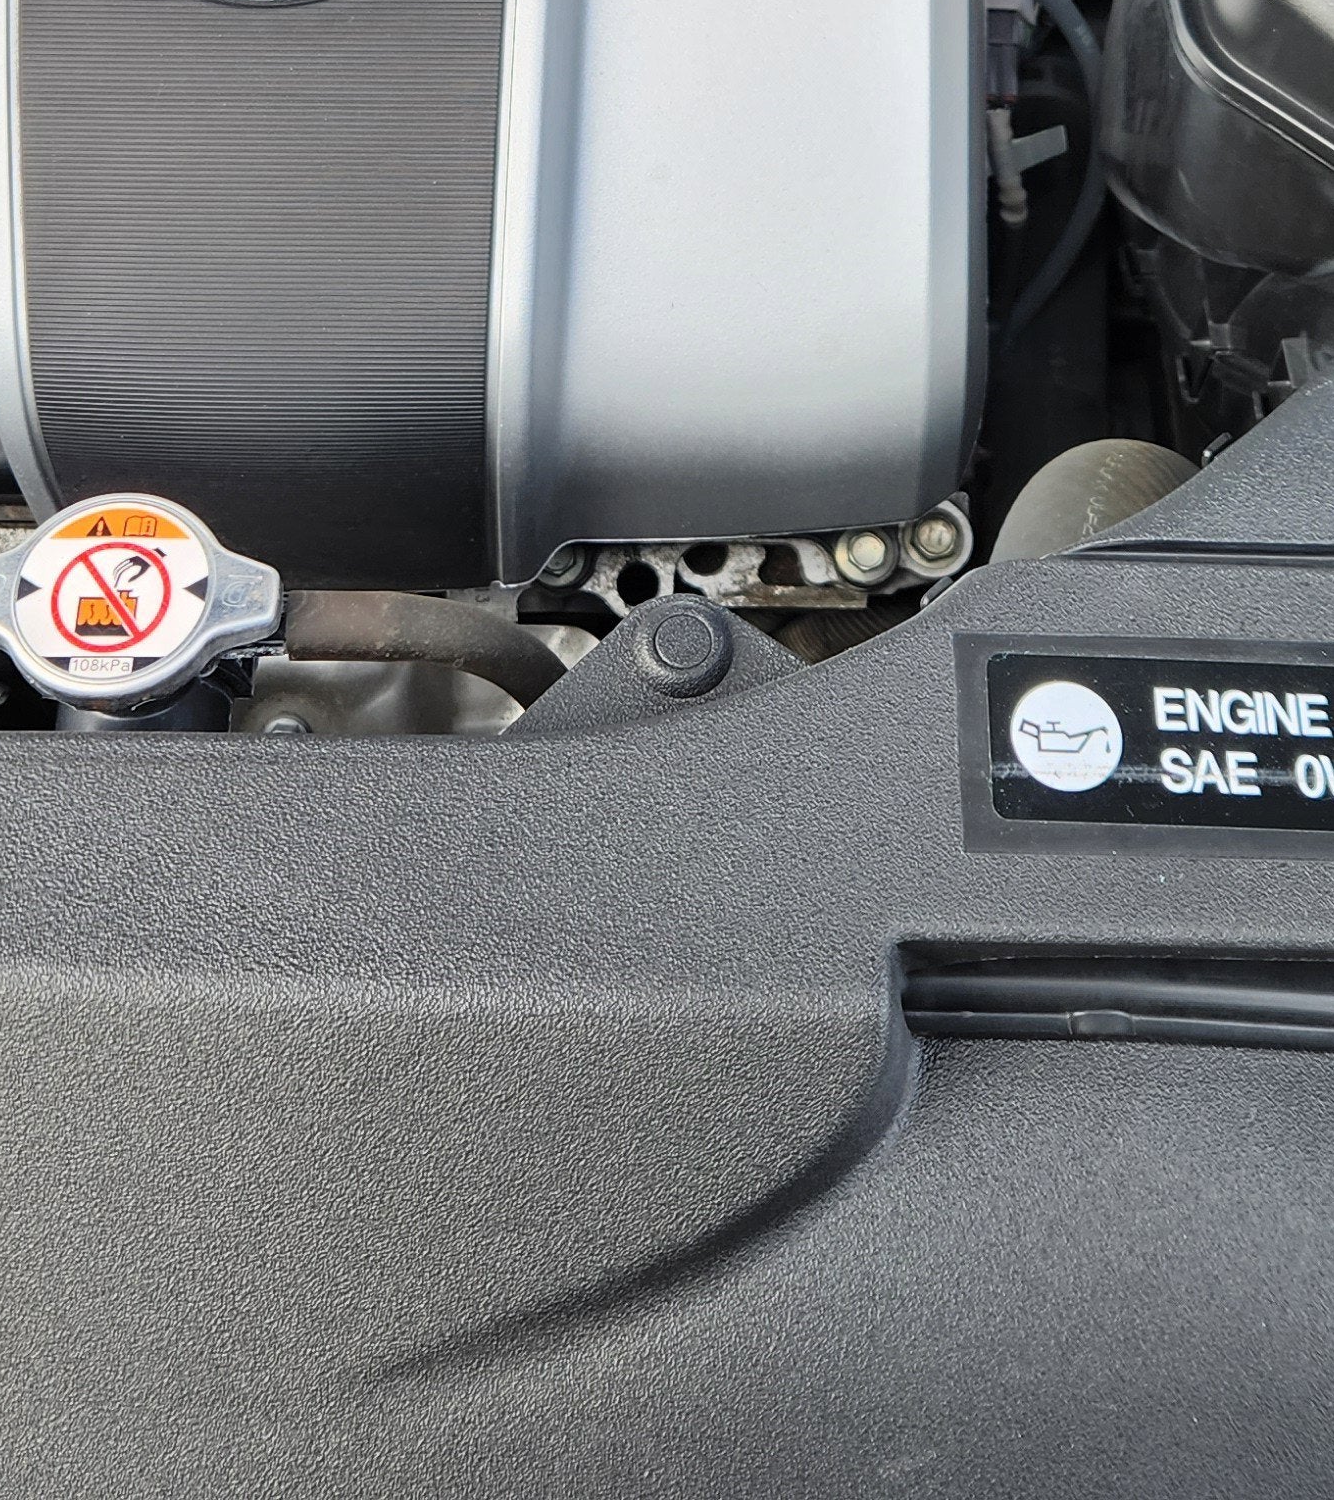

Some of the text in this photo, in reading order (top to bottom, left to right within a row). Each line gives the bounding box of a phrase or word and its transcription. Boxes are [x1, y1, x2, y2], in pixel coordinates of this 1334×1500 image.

[71, 657, 132, 674] 108kPa
[1153, 685, 1334, 738] ENGINE
[1159, 746, 1262, 797] SAE
